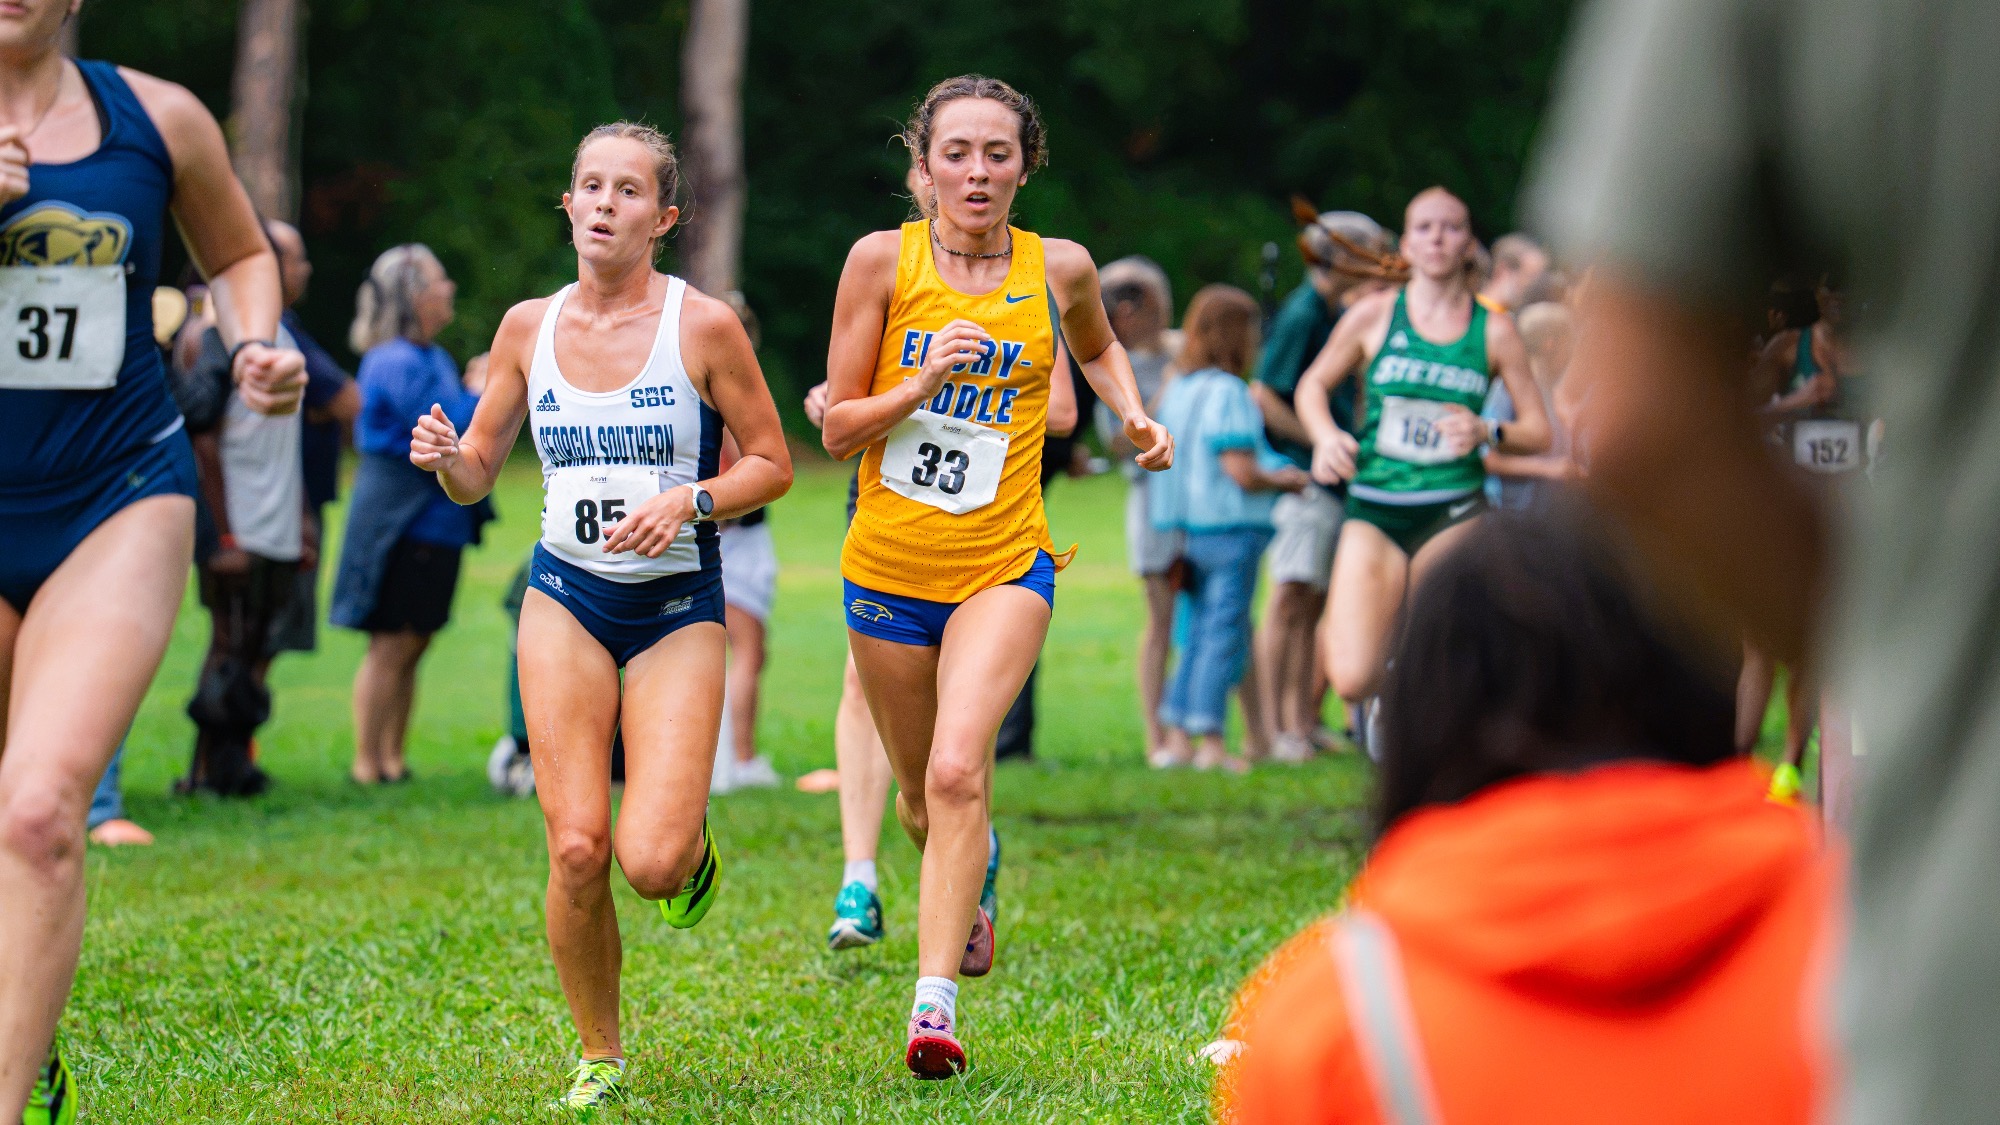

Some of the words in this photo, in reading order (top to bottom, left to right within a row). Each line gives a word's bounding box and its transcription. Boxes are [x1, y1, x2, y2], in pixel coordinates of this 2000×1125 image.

[18, 306, 78, 361] 37
[536, 402, 560, 412] adidas
[630, 385, 675, 408] SBC
[539, 425, 600, 468] GEORGIA
[597, 424, 674, 466] SOUTHERN
[1807, 438, 1848, 464] 152
[912, 442, 969, 494] 33
